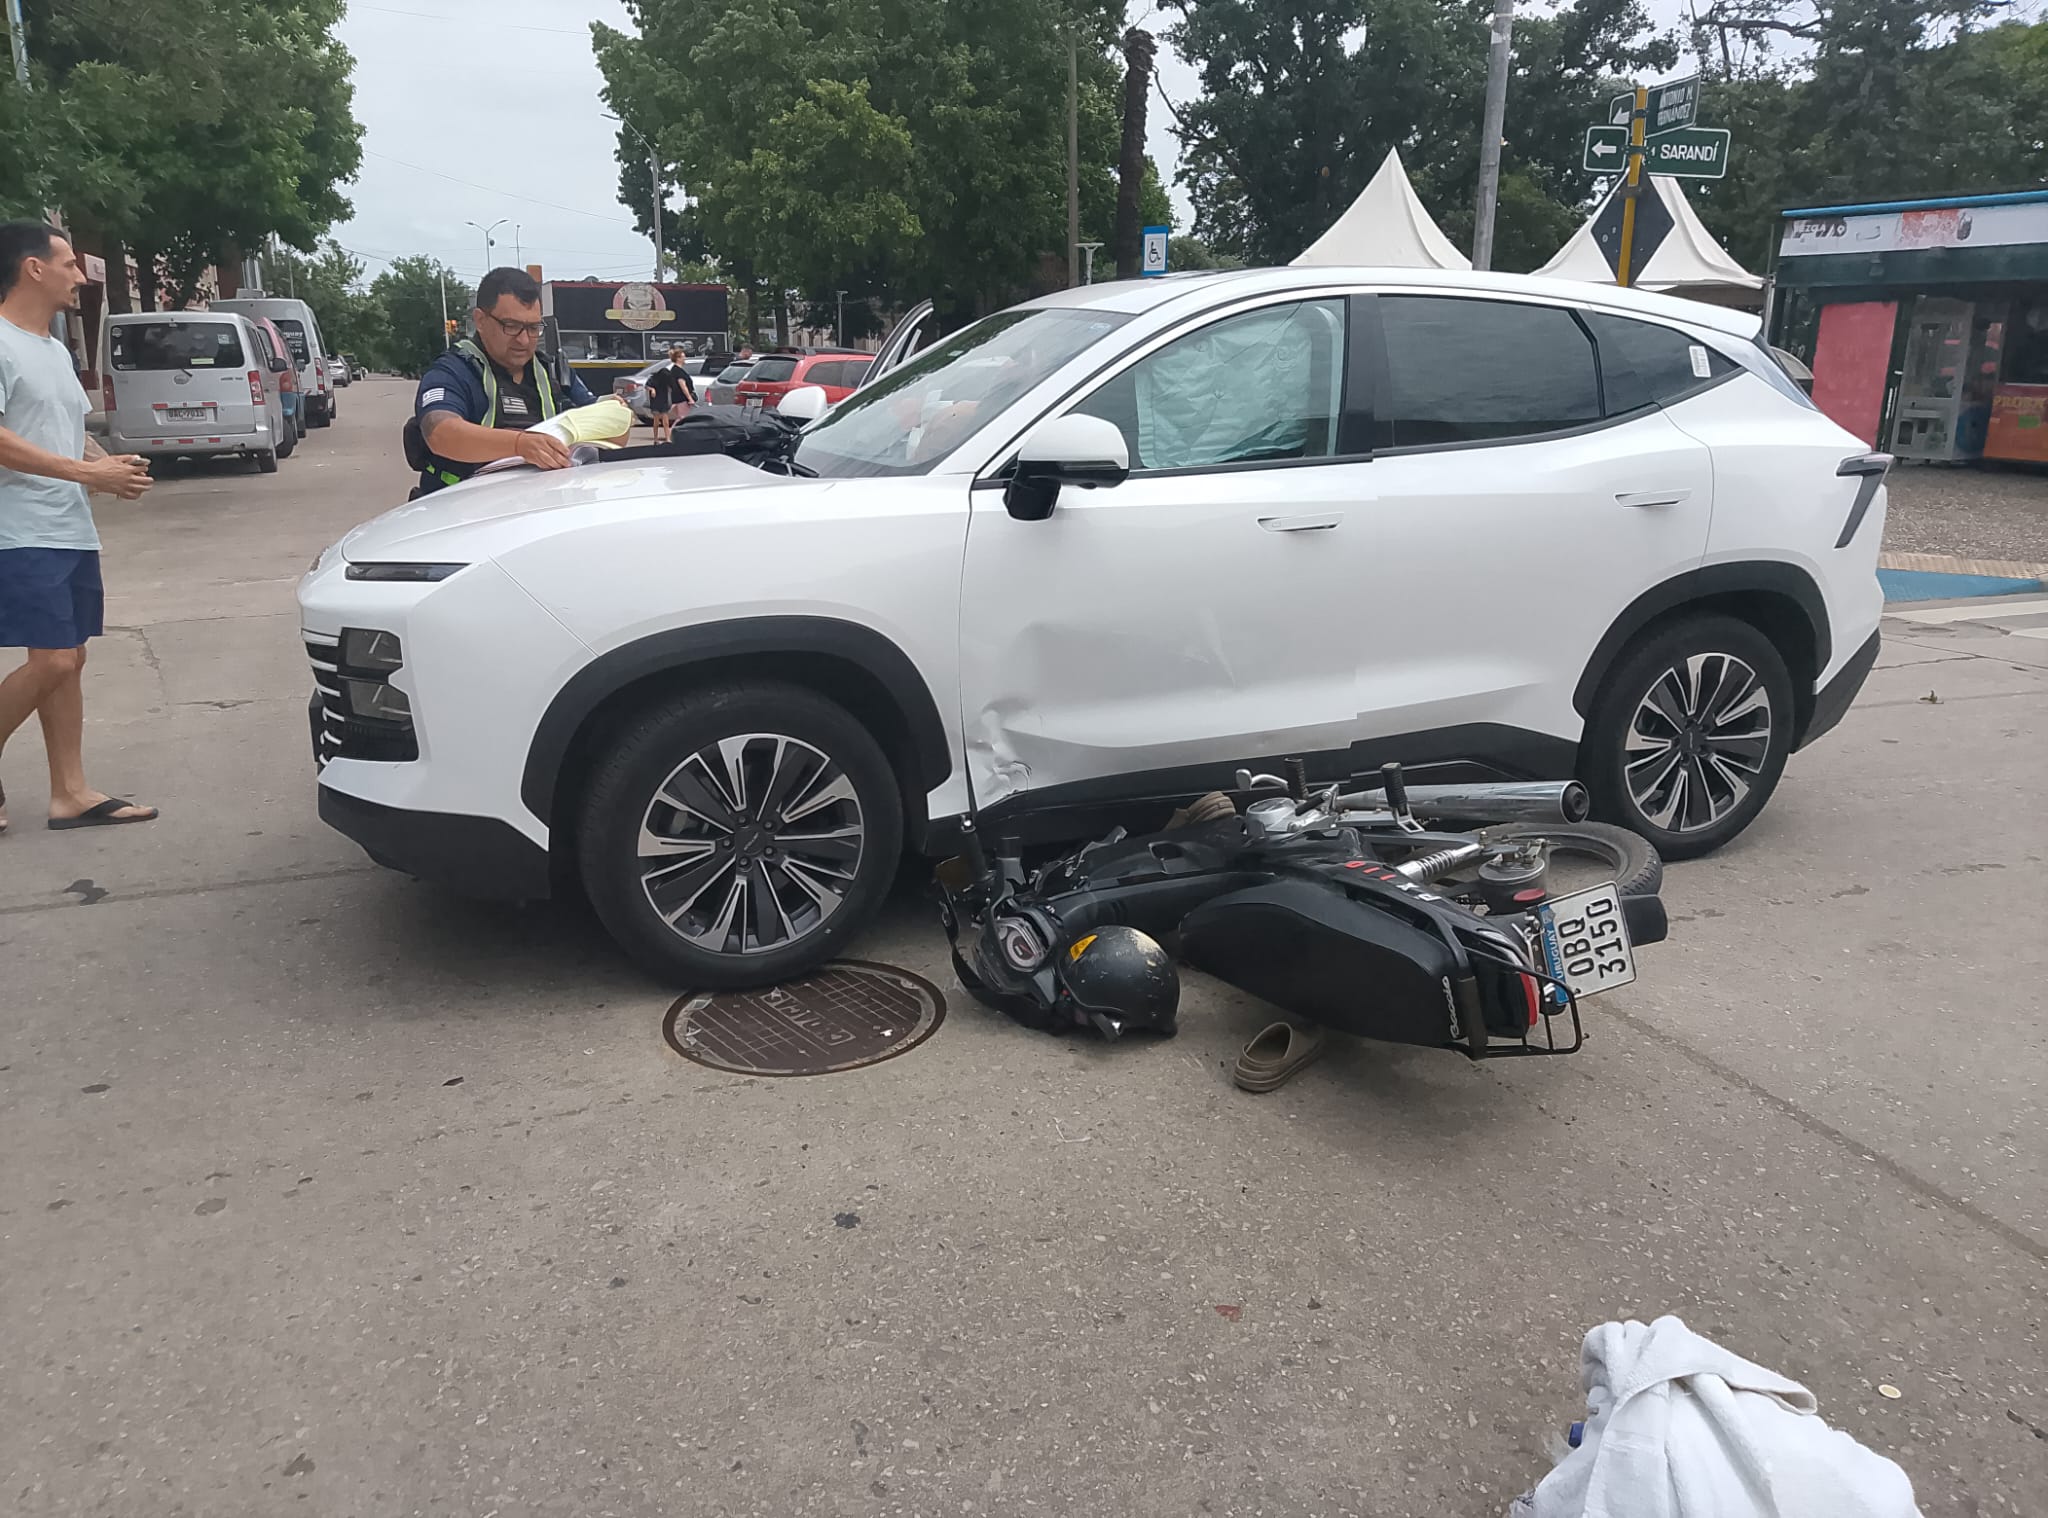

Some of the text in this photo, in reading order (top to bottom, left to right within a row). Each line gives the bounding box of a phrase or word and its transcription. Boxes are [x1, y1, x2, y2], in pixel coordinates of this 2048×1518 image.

[1660, 140, 1720, 161] SARANDÍ
[1548, 929, 1564, 979] URUGUAY
[1558, 917, 1595, 976] OBQ
[1586, 898, 1626, 978] 3150
